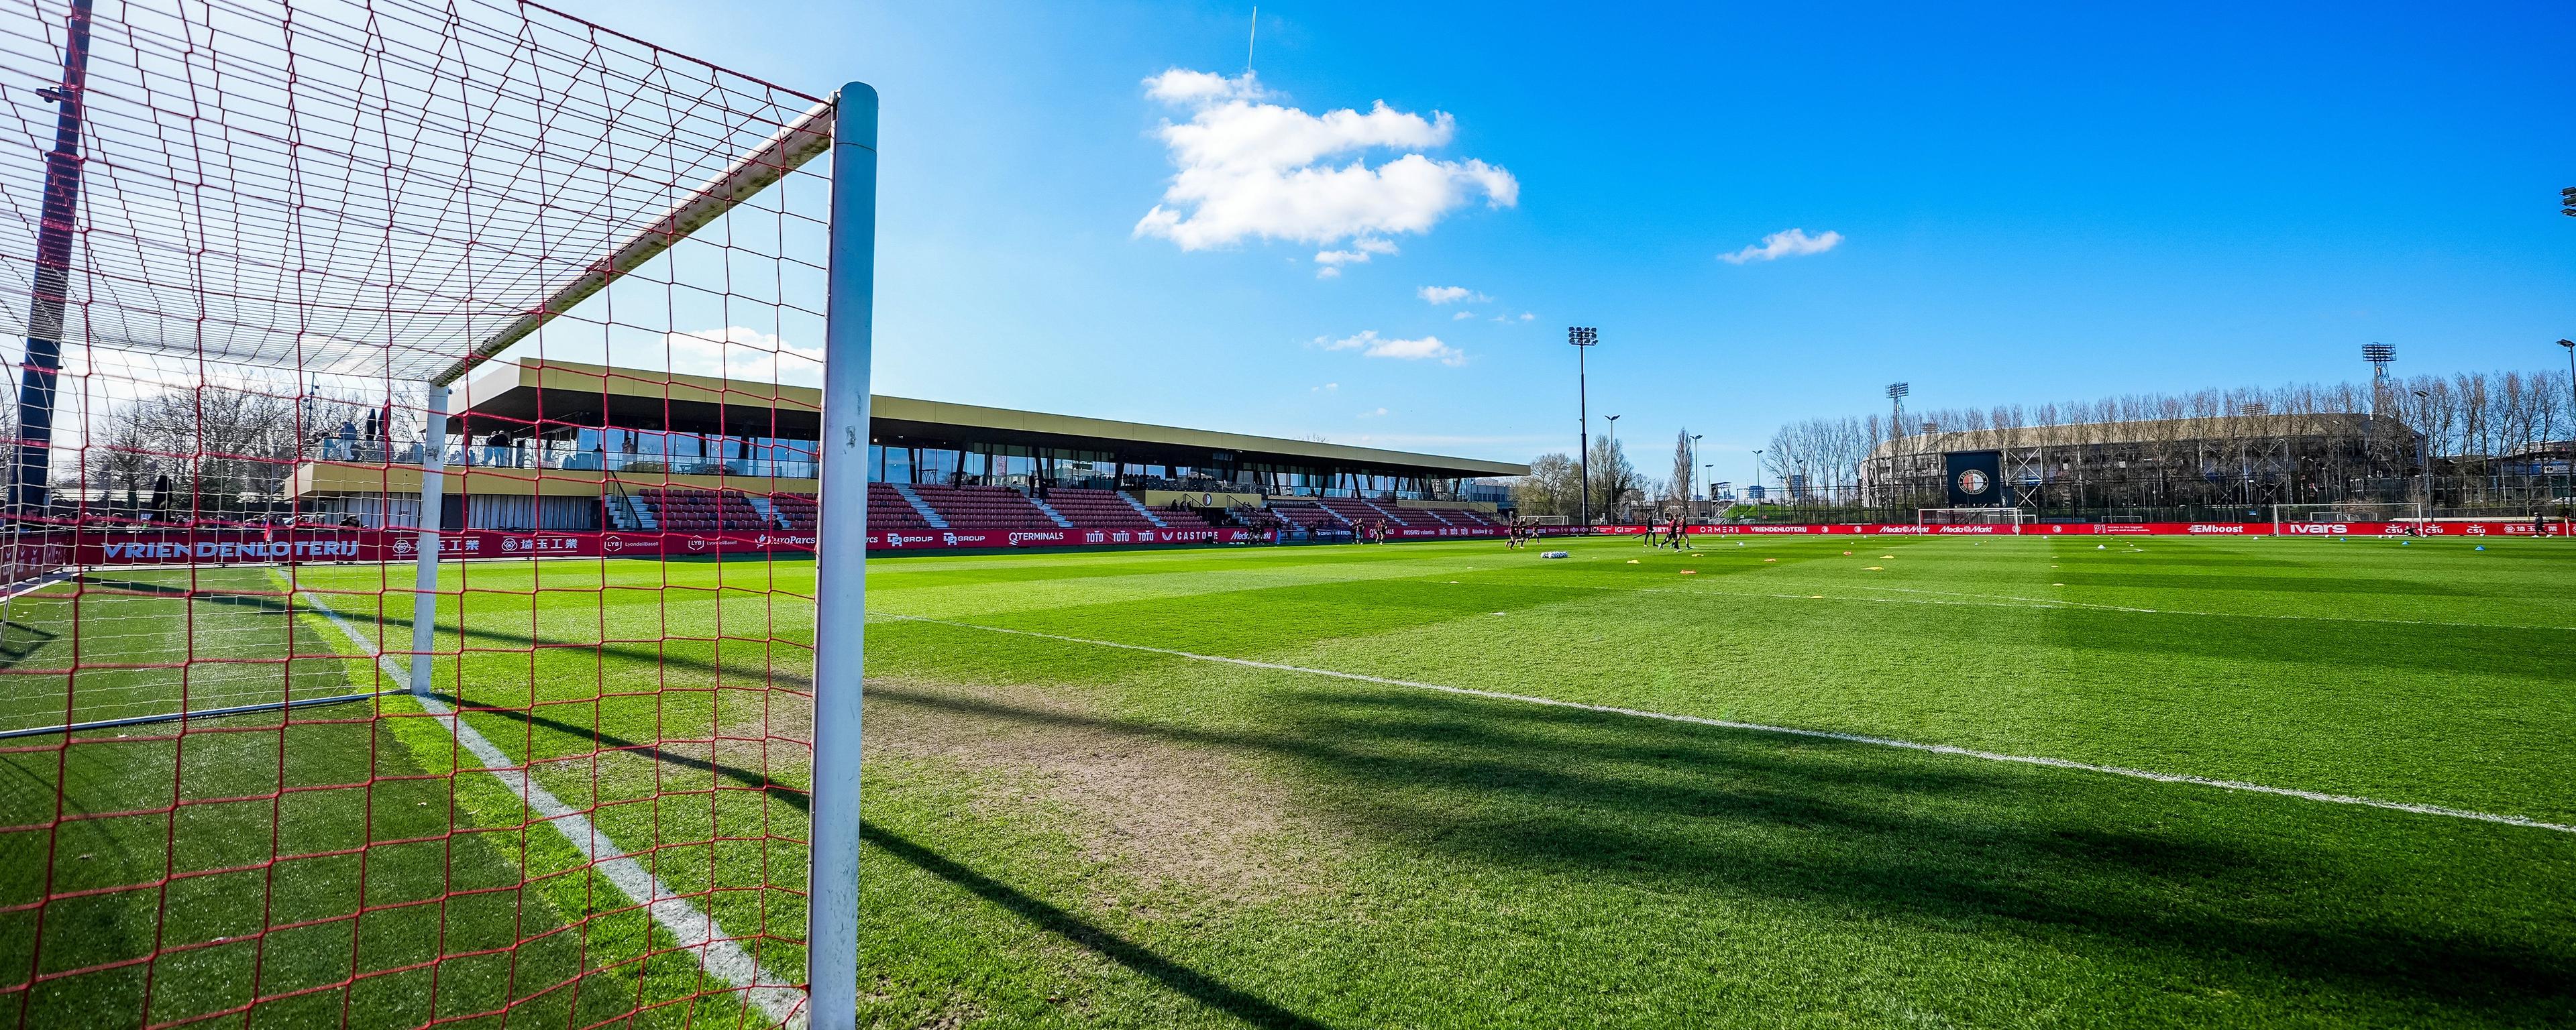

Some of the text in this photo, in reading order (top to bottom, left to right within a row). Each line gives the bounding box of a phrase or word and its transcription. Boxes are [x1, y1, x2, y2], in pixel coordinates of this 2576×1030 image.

[1086, 531, 1104, 542] TOTO
[1112, 531, 1130, 542] TOTO
[1138, 530, 1154, 541] TOTO
[520, 538, 578, 549] 埼玉工業
[101, 541, 358, 558] VRIENDENLOTERIJ
